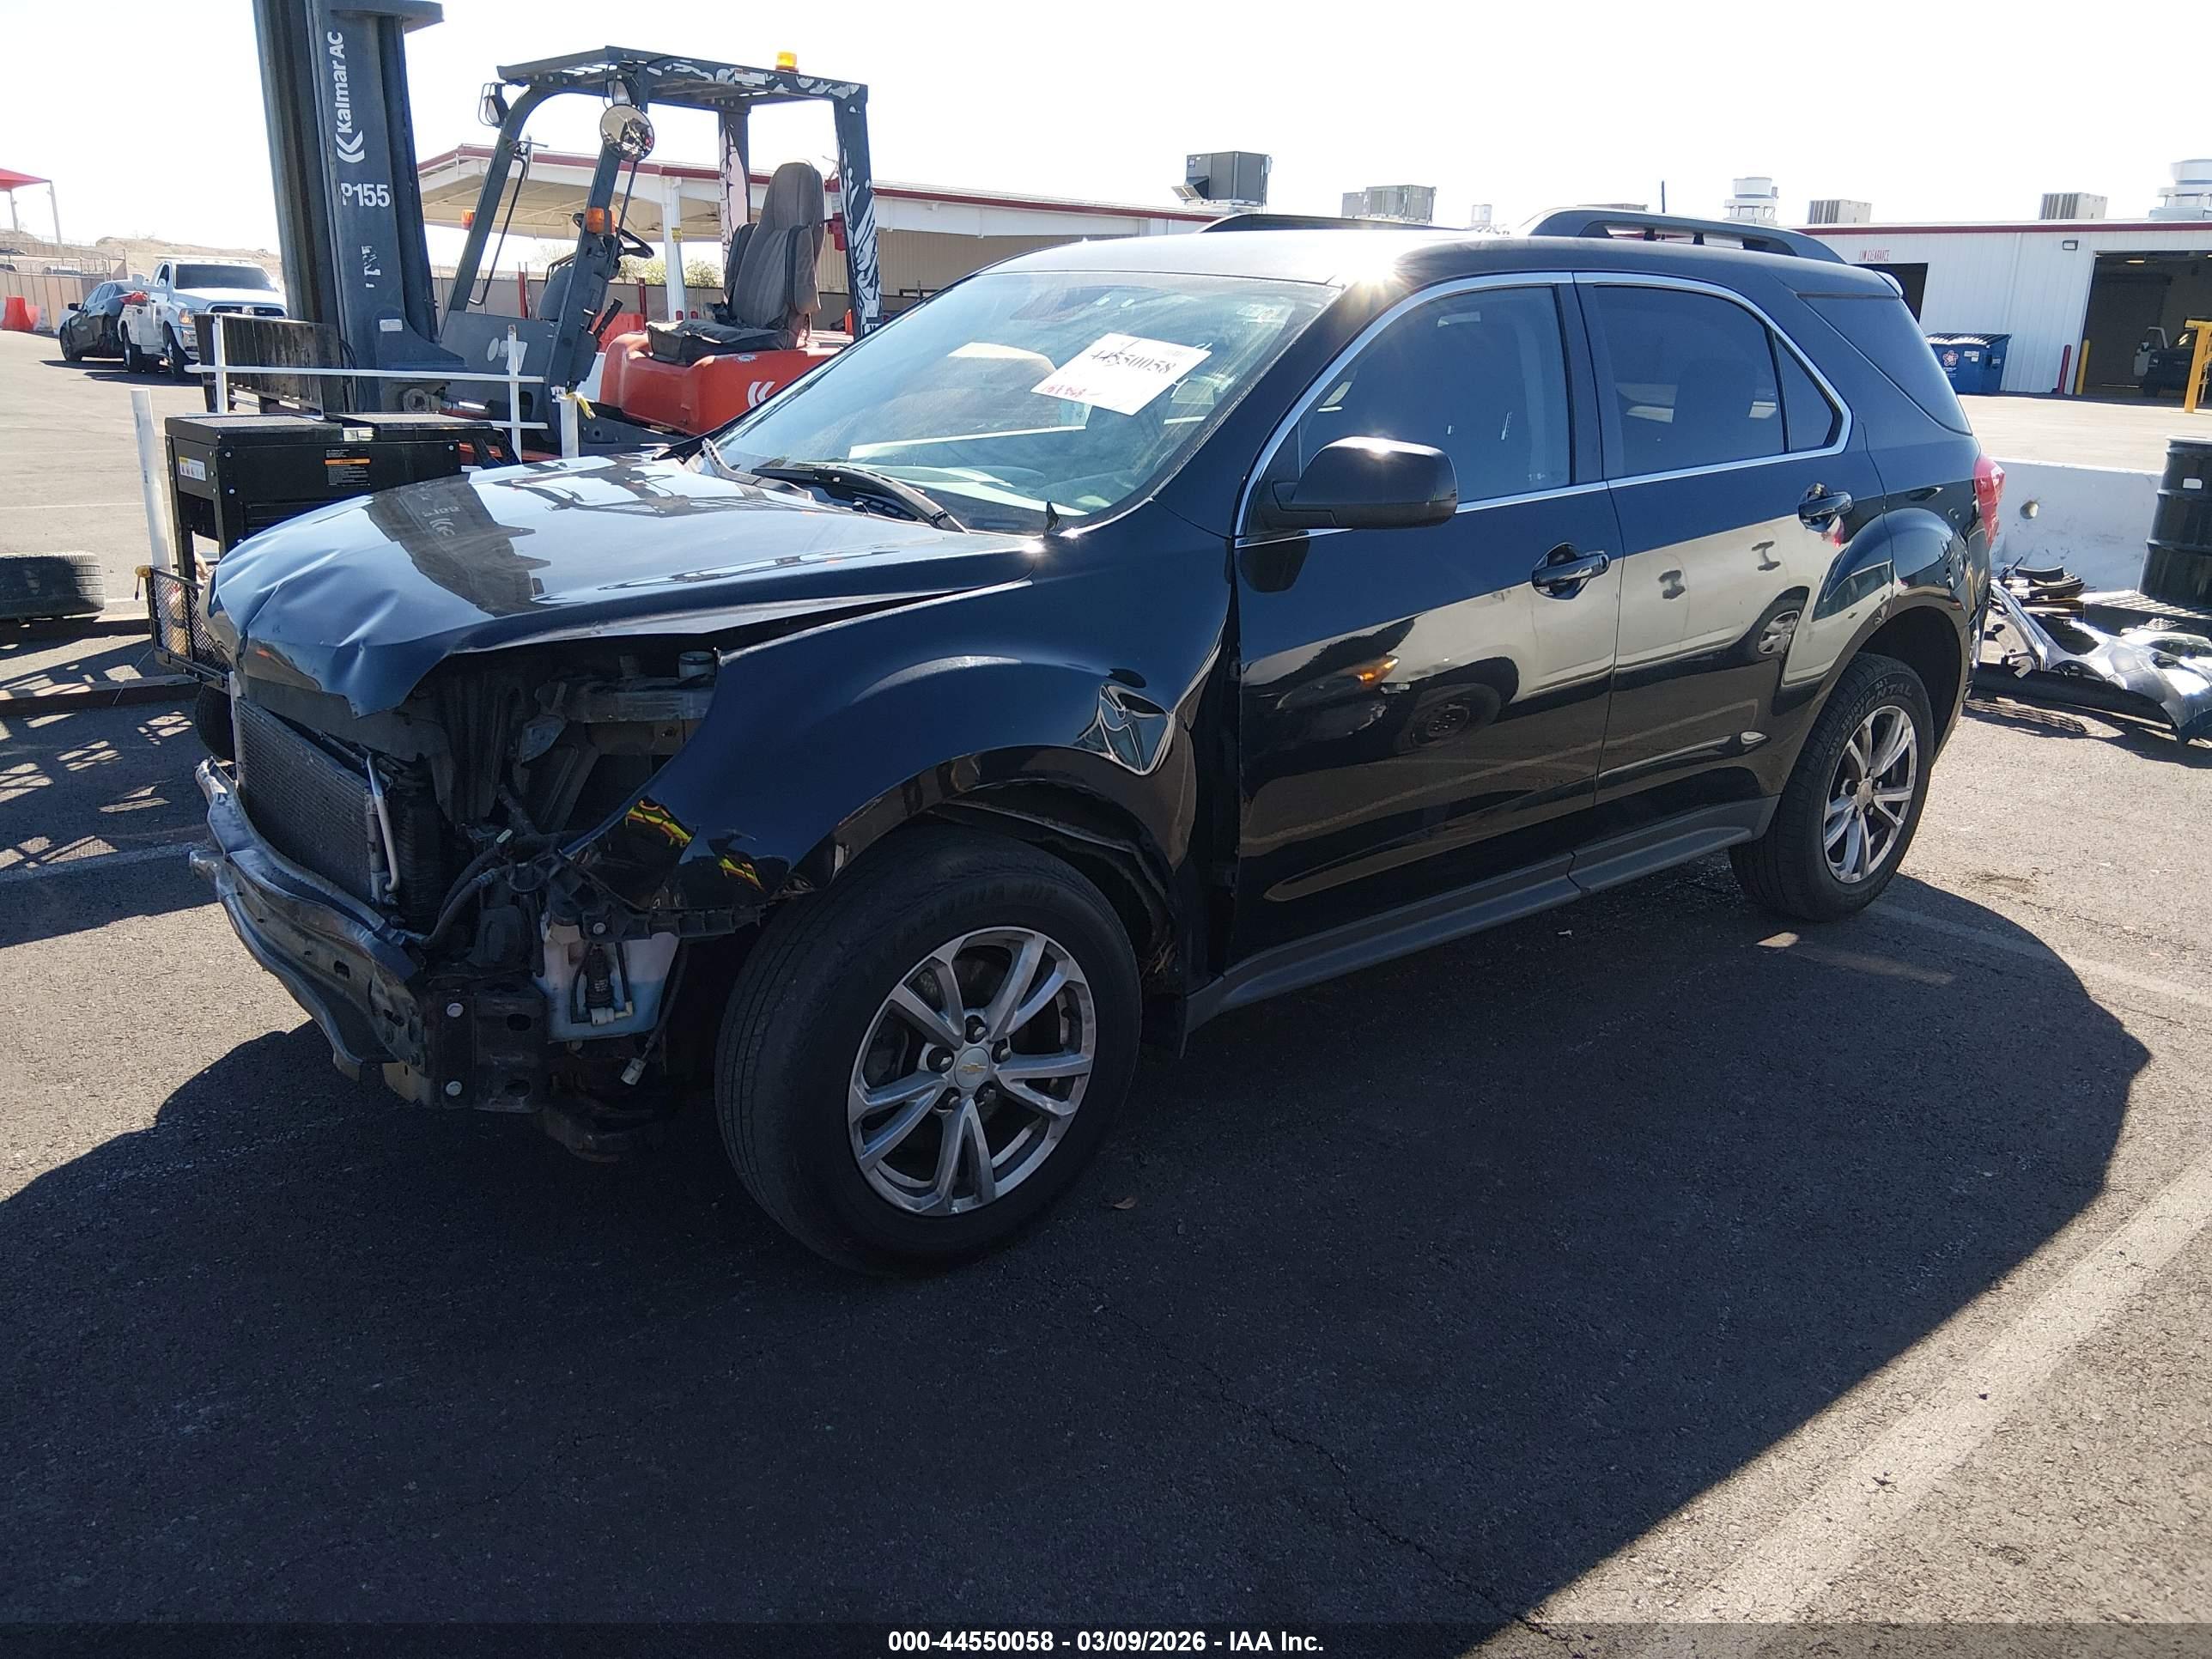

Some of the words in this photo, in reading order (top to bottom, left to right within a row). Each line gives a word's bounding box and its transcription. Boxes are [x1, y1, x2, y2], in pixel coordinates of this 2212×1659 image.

[327, 31, 345, 59] AC
[332, 60, 352, 133] Kalmar
[340, 183, 391, 207] P155
